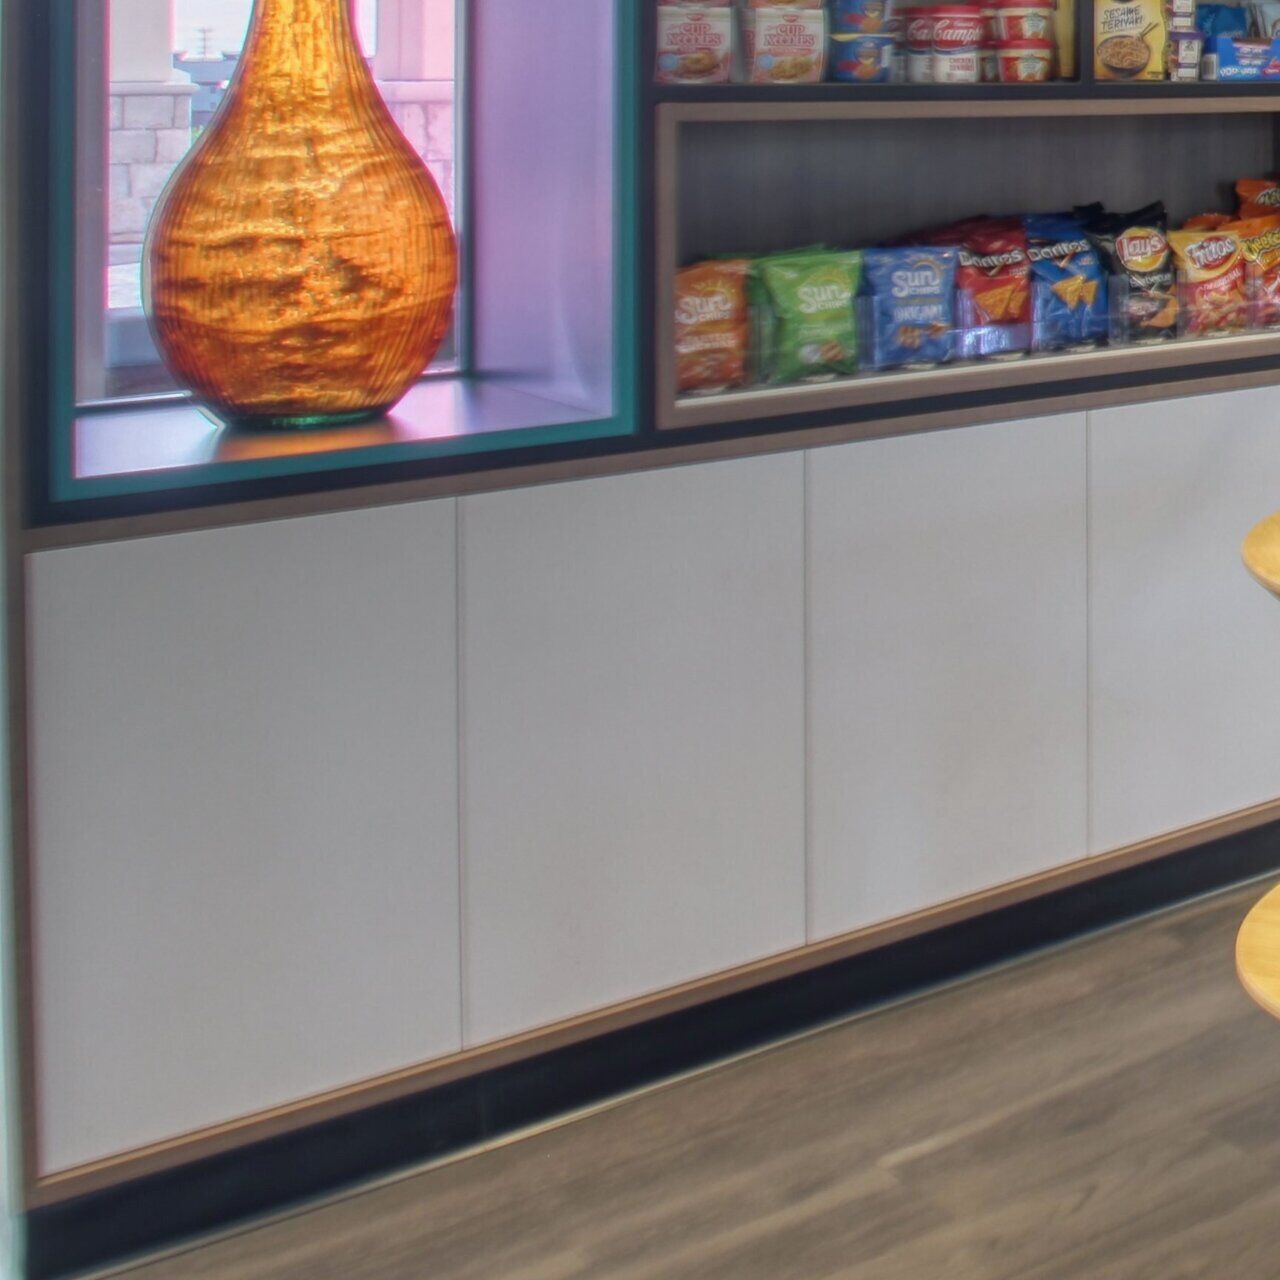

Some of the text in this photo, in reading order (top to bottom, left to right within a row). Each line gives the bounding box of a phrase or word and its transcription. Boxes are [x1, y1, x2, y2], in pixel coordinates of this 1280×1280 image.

[1103, 5, 1141, 20] SESAME
[681, 23, 711, 35] CUP
[774, 24, 804, 37] CUP
[1101, 16, 1143, 32] TERIYAKI
[667, 34, 722, 47] NOODLES
[761, 34, 815, 47] NOODLES
[1027, 239, 1089, 262] Doritos
[1185, 237, 1234, 269] Fritos
[892, 269, 941, 298] Sun
[908, 285, 940, 294] CHIPS
[798, 284, 851, 314] Sun
